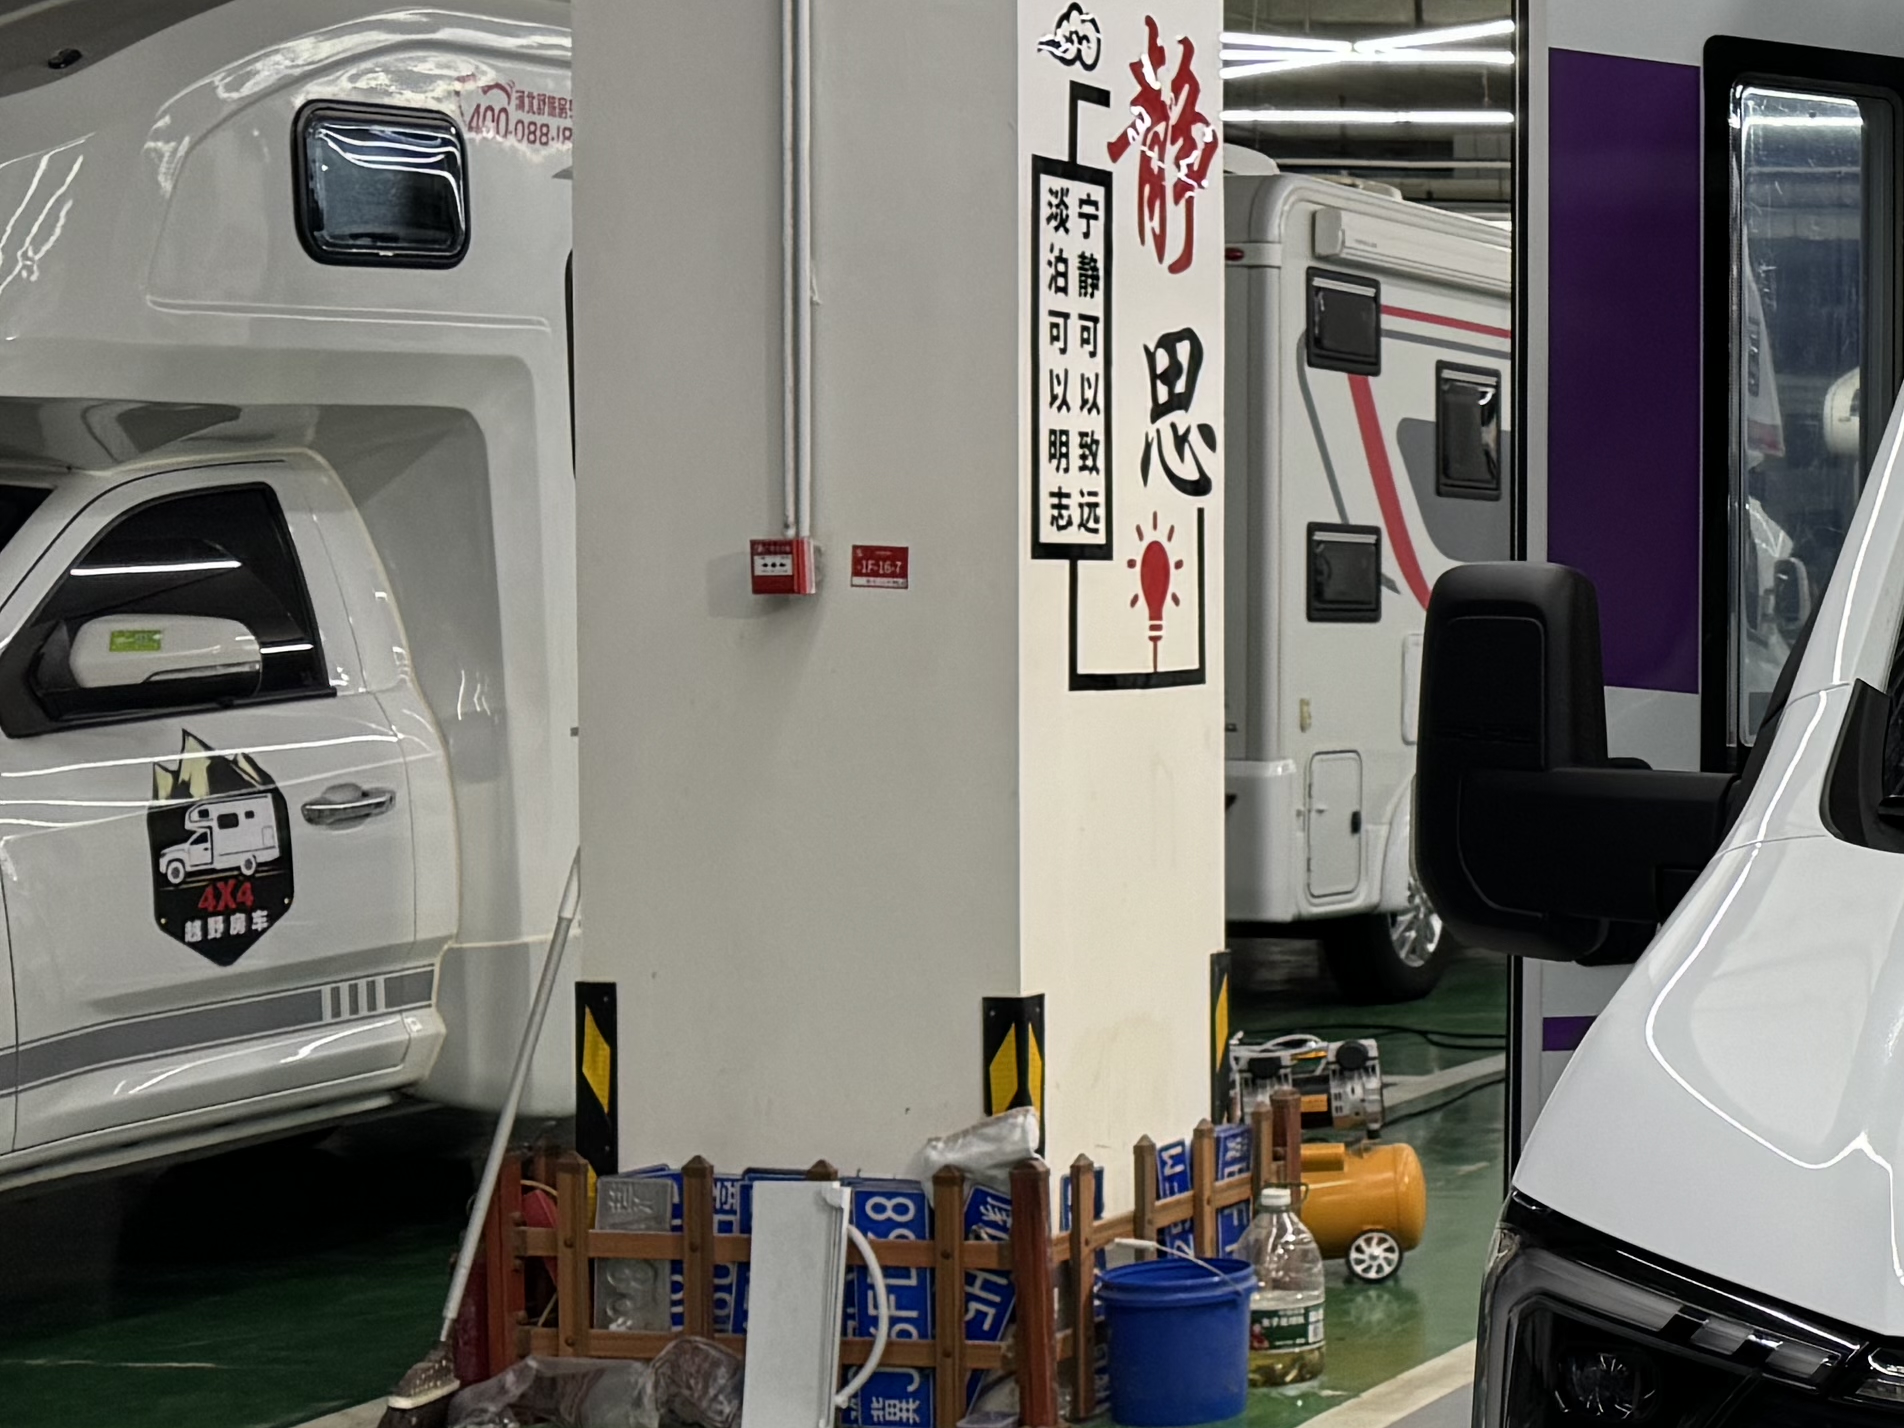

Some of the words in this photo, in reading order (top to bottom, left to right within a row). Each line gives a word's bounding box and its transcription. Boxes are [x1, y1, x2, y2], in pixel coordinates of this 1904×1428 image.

[1046, 187, 1072, 532] 淡泊可以明志
[1076, 194, 1101, 534] 宁静可以致远
[198, 879, 255, 912] 4X4
